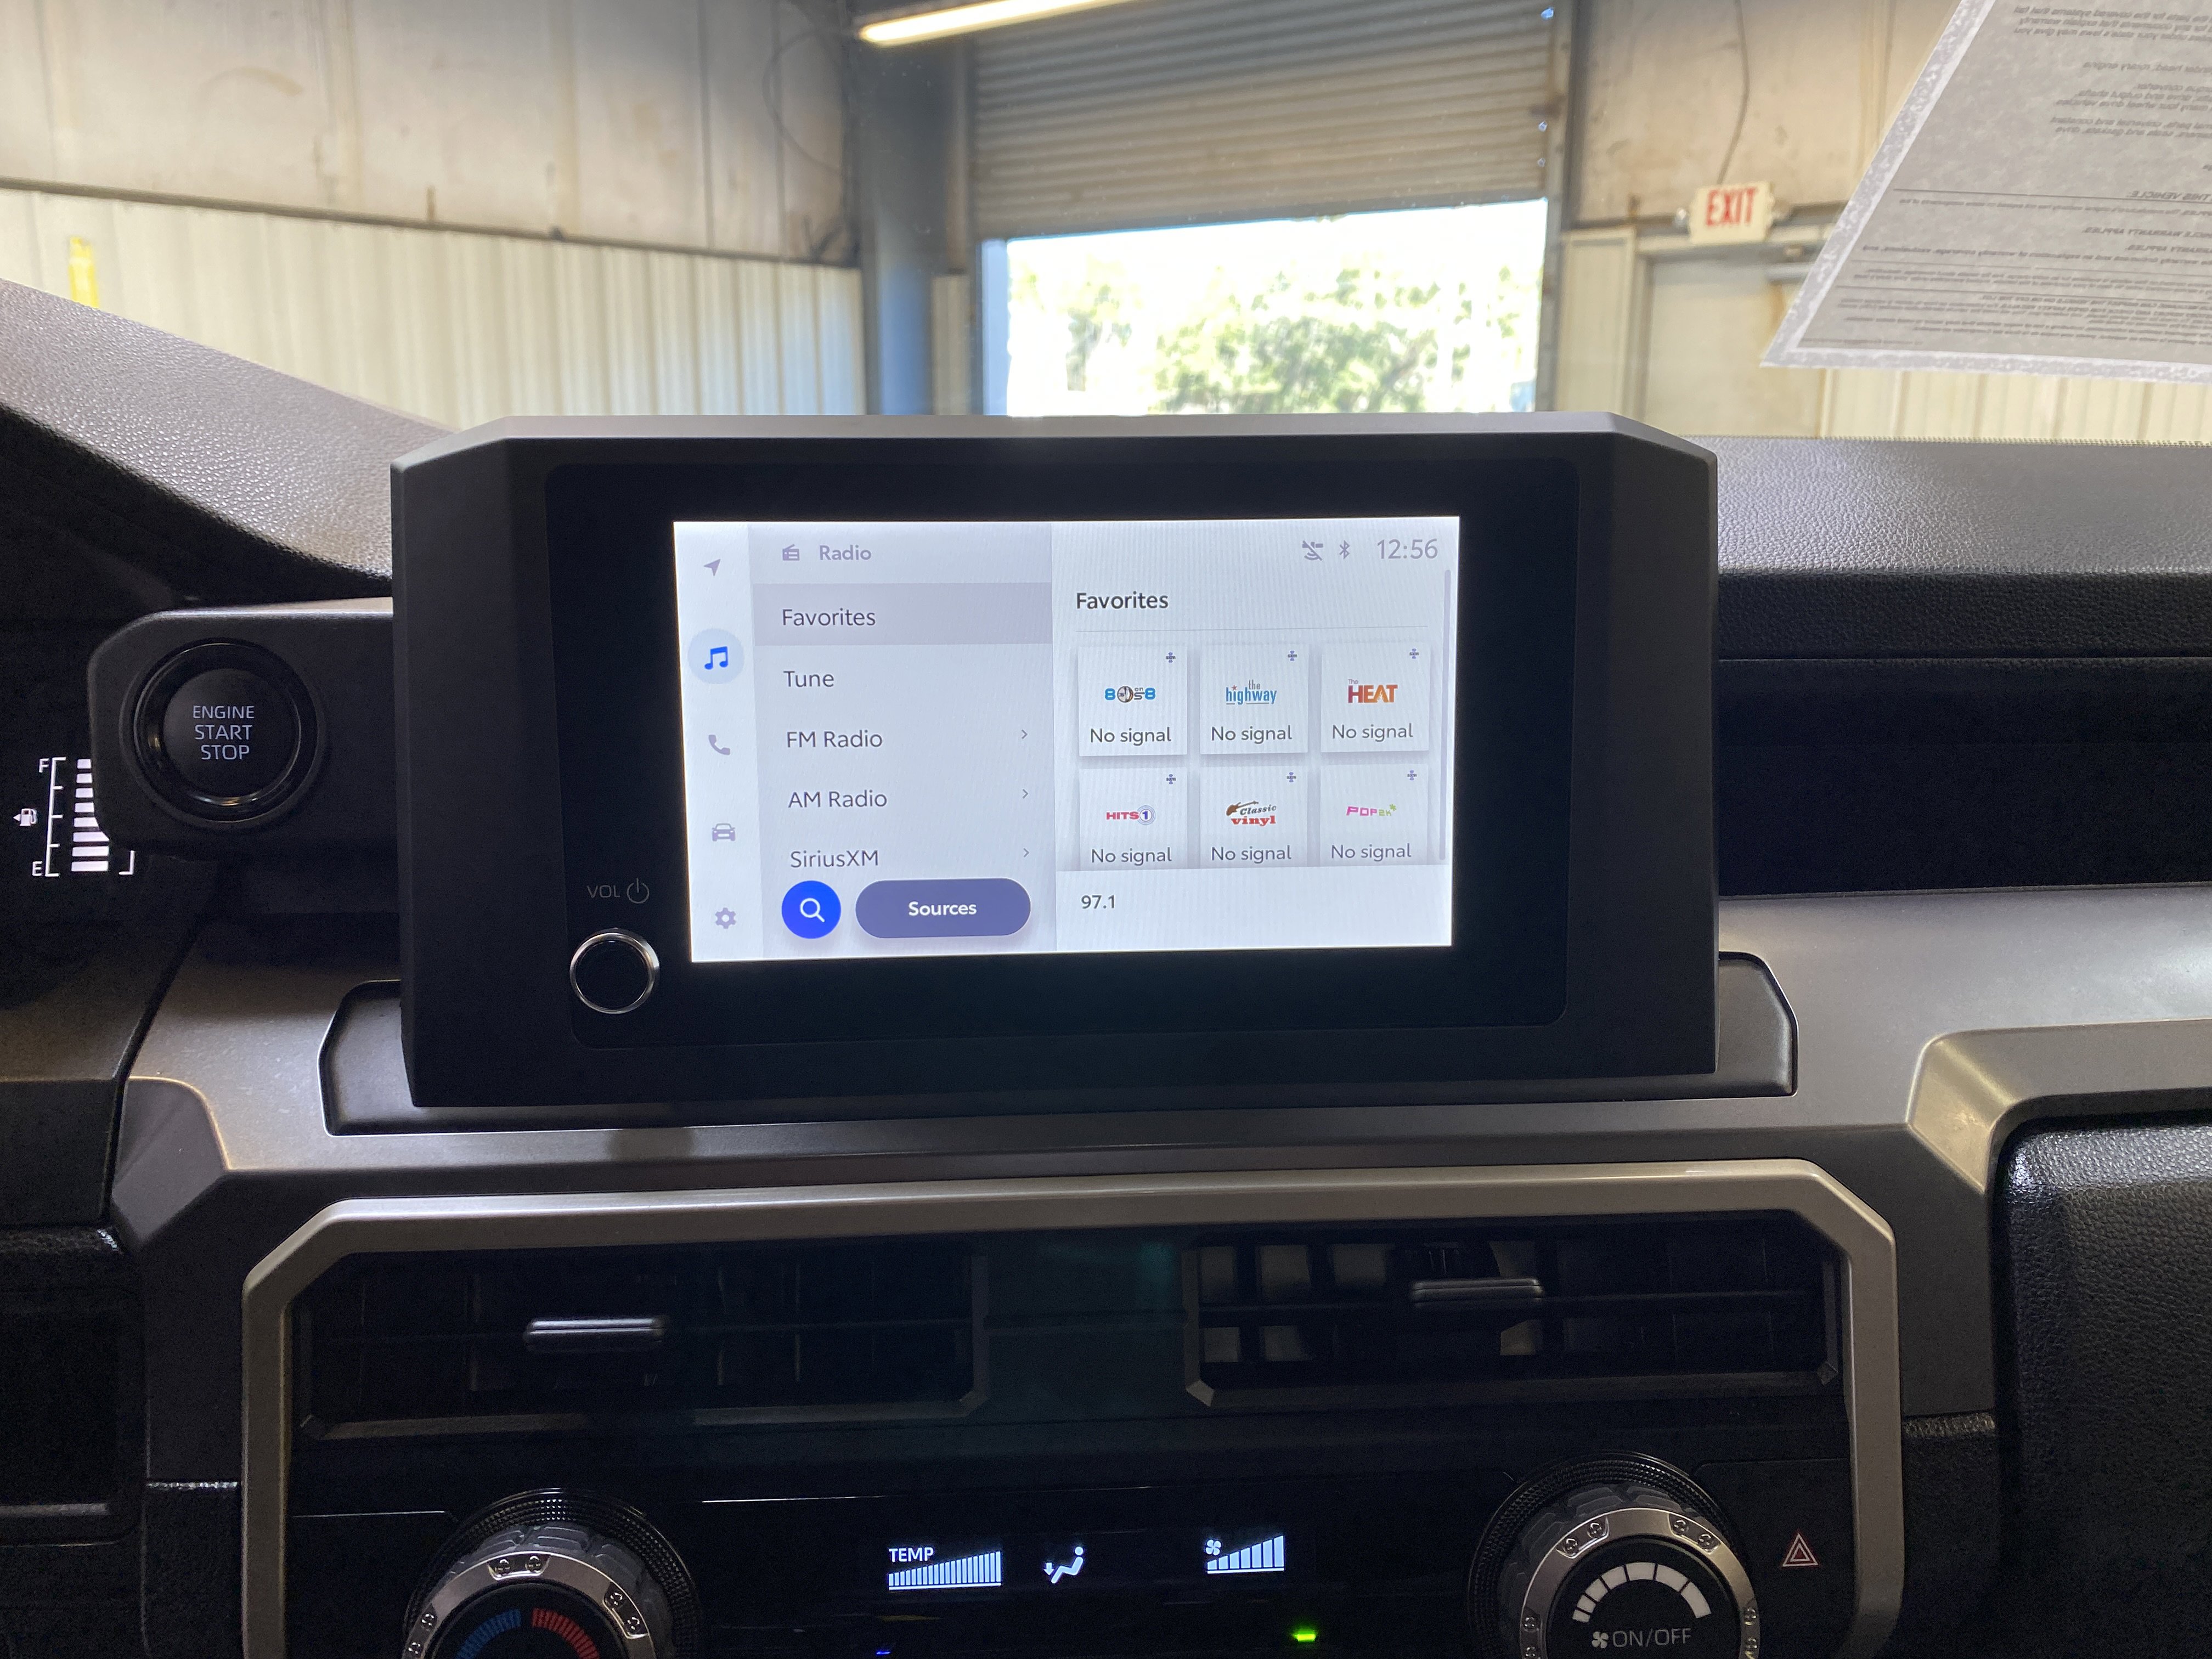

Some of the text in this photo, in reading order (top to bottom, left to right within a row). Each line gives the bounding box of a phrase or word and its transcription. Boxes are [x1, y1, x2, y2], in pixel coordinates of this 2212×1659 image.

[1706, 187, 1758, 226] EXIT
[819, 545, 871, 560] Radio
[1377, 538, 1438, 559] 12:56
[1076, 590, 1169, 609] Favorites
[783, 607, 876, 626] Favorites
[783, 671, 834, 687] Tune
[1249, 679, 1261, 690] the
[1226, 686, 1277, 704] highway
[1348, 685, 1398, 703] HEAT
[193, 706, 255, 719] ENGINE
[195, 724, 252, 740] START
[787, 730, 883, 747] FM Radio
[1091, 726, 1171, 746] No signal
[1211, 725, 1292, 744] No signal
[1333, 723, 1413, 742] No signal
[201, 744, 250, 760] STOP
[38, 758, 49, 773] F
[788, 789, 887, 808] AM Radio
[1106, 811, 1139, 820] HITS
[1240, 804, 1277, 815] Classic
[1231, 815, 1276, 827] vinyl
[790, 850, 878, 868] SiriusXM
[1092, 847, 1172, 866] No signal
[1211, 845, 1291, 864] No signal
[1331, 843, 1412, 862] No signal
[32, 861, 43, 876] E
[587, 885, 620, 898] VOL
[908, 901, 977, 916] Sources
[1081, 895, 1114, 909] 97.1
[888, 1547, 934, 1562] TEMP
[1612, 1628, 1691, 1647] ON/OFF
